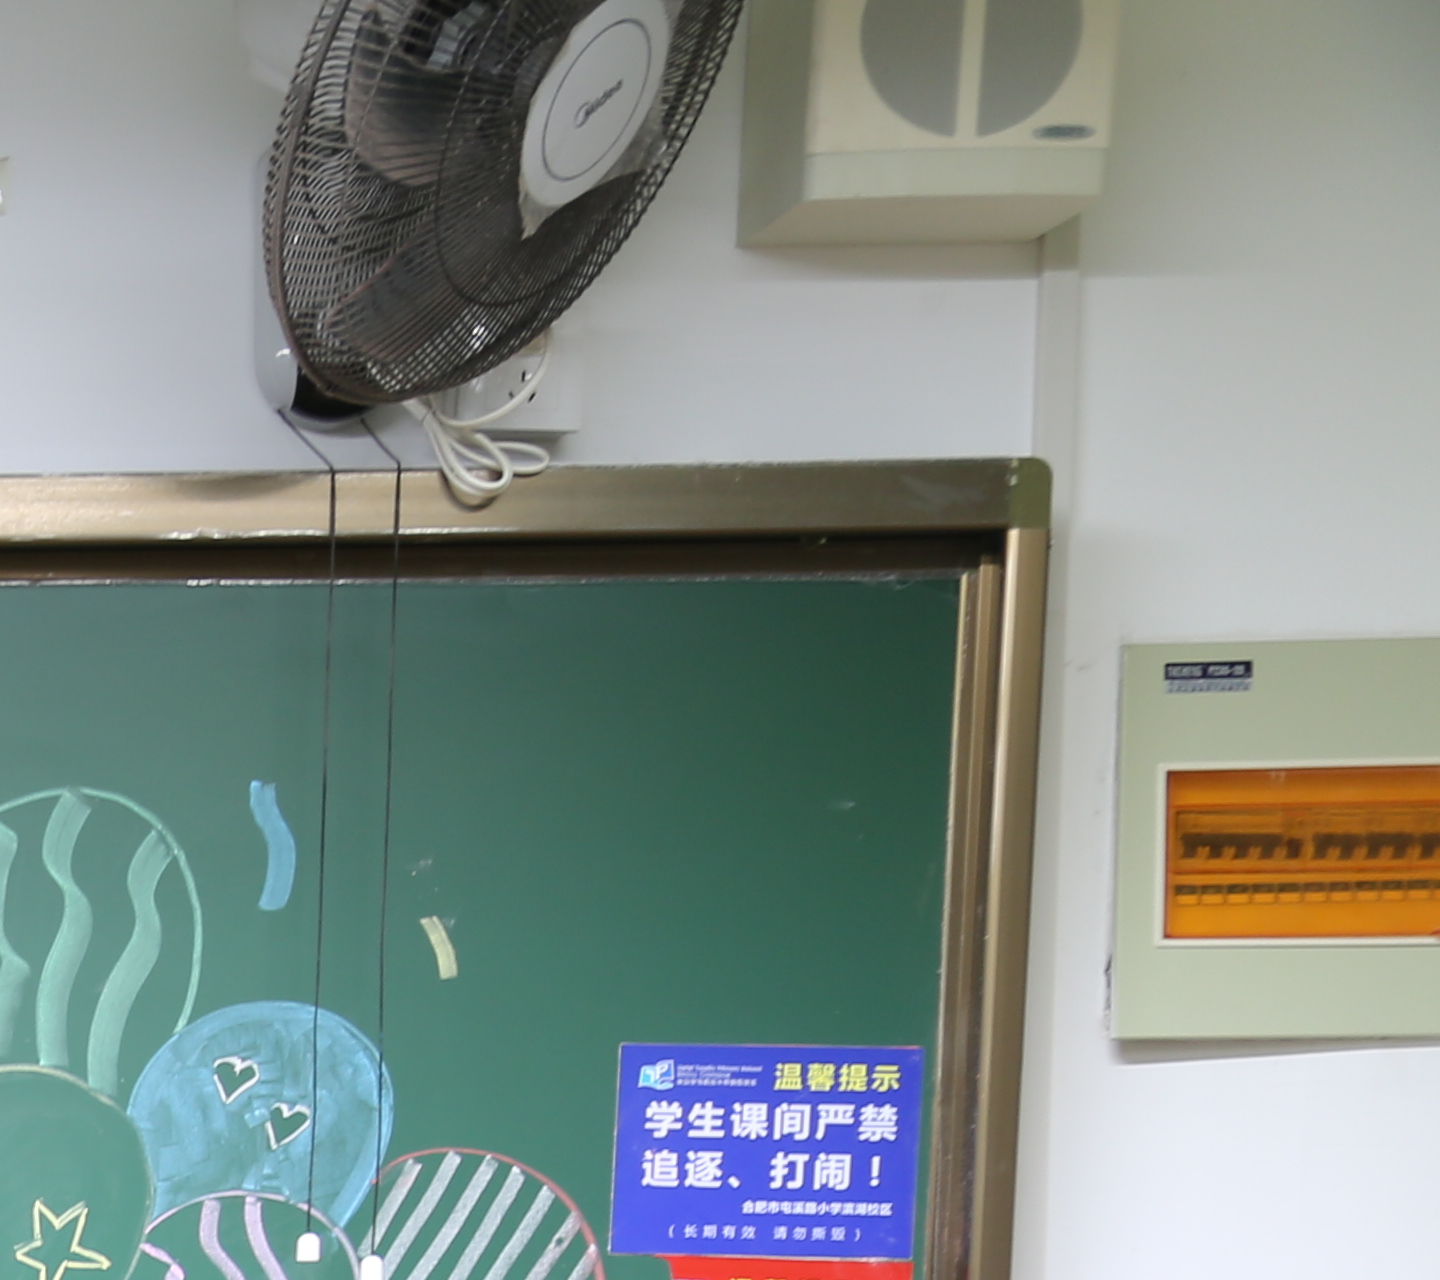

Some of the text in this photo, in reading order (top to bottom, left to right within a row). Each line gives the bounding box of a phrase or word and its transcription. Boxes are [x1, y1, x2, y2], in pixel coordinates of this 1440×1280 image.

[773, 1062, 901, 1093] 温馨提示
[643, 1100, 900, 1142] 学生课间严禁
[640, 1149, 883, 1191] 追逐、打闹！
